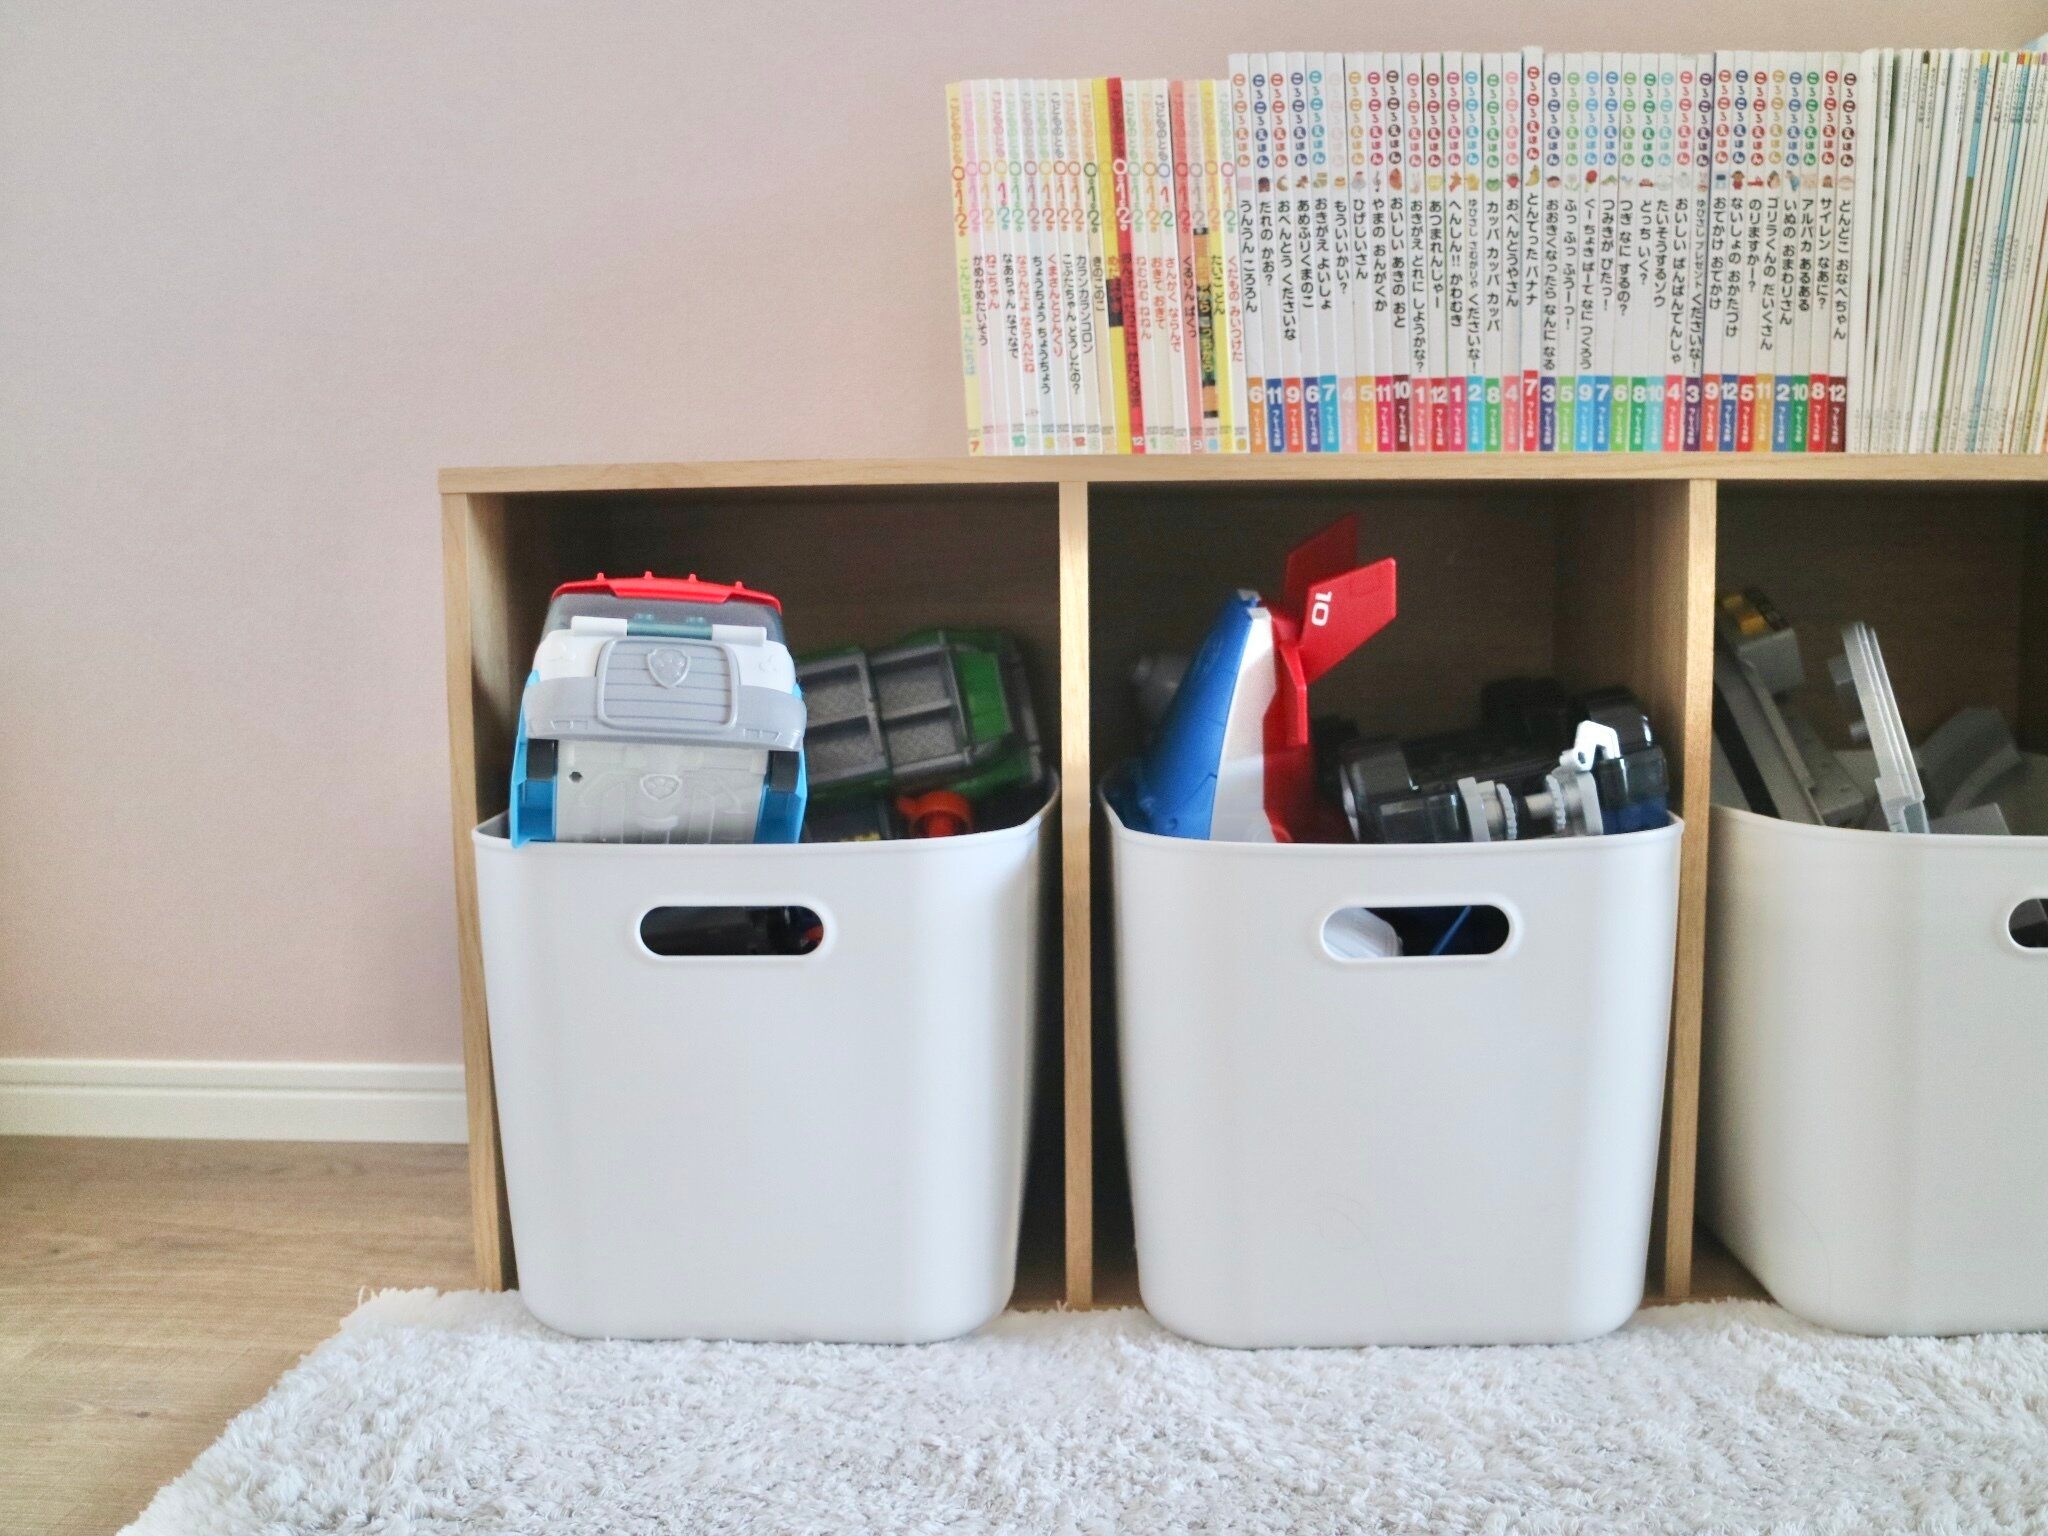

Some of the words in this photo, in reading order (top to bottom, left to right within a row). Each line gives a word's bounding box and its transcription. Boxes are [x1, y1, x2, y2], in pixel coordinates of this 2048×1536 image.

[1241, 200, 1255, 253] うんうん
[1315, 198, 1329, 251] おきがえ
[1372, 199, 1385, 238] やまの
[1391, 198, 1404, 250] おいしい
[1410, 200, 1423, 250] おきがえ
[1486, 201, 1500, 240] カッパ
[1602, 199, 1615, 252] つみきが
[1674, 198, 1688, 251] おいしい
[1783, 199, 1797, 238] いぬの
[1818, 198, 1832, 250] サイレン
[1728, 197, 1743, 264] ないしょの
[1545, 199, 1559, 299] おおきくなったら
[1619, 231, 1631, 257] なに
[1486, 247, 1500, 286] カッパ
[1318, 258, 1332, 310] よいしょ
[1392, 256, 1405, 296] あきの
[1798, 258, 1811, 312] あるある
[1033, 255, 1046, 323] ちょうちょう
[1526, 266, 1539, 306] バナナ
[1780, 245, 1795, 326] おまわりさん
[1076, 254, 1093, 354] カランカランコロン
[1486, 292, 1500, 331] カッパ
[1581, 299, 1593, 321] なに
[1394, 302, 1406, 328] おと
[1544, 304, 1557, 341] なんに
[1580, 325, 1593, 370] つくろう
[1037, 327, 1051, 395] ちょうちょう
[1543, 346, 1556, 371] なる
[1249, 386, 1263, 403] 6
[1267, 387, 1282, 404] 11
[1286, 386, 1300, 403] 9
[1305, 385, 1319, 402] 6
[1322, 384, 1336, 401] 7
[1343, 387, 1355, 403] 4
[1360, 386, 1374, 402] 5
[1376, 386, 1391, 402] 11
[1393, 382, 1410, 399] 10
[1415, 386, 1425, 403] 1
[1431, 386, 1447, 403] 12
[1452, 386, 1462, 402] 1
[1468, 384, 1481, 401] 2
[1487, 387, 1500, 404] 8
[1505, 385, 1518, 402] 4
[1524, 378, 1538, 396] 7
[1541, 385, 1556, 402] 3
[1561, 386, 1574, 402] 5
[1578, 384, 1592, 401] 9
[1596, 384, 1610, 402] 7
[1613, 385, 1628, 402] 6
[1633, 385, 1646, 403] 8
[1648, 384, 1664, 401] 10
[1667, 383, 1680, 401] 4
[1686, 385, 1700, 403] 3
[1704, 382, 1718, 400] 9
[1721, 383, 1737, 400] 12
[1740, 384, 1754, 401] 5
[1756, 383, 1772, 400] 11
[1776, 384, 1790, 402] 2
[1793, 384, 1808, 401] 10
[1811, 383, 1825, 400] 8
[1829, 384, 1846, 402] 12
[1132, 436, 1144, 446] 12
[1311, 591, 1332, 626] 10
